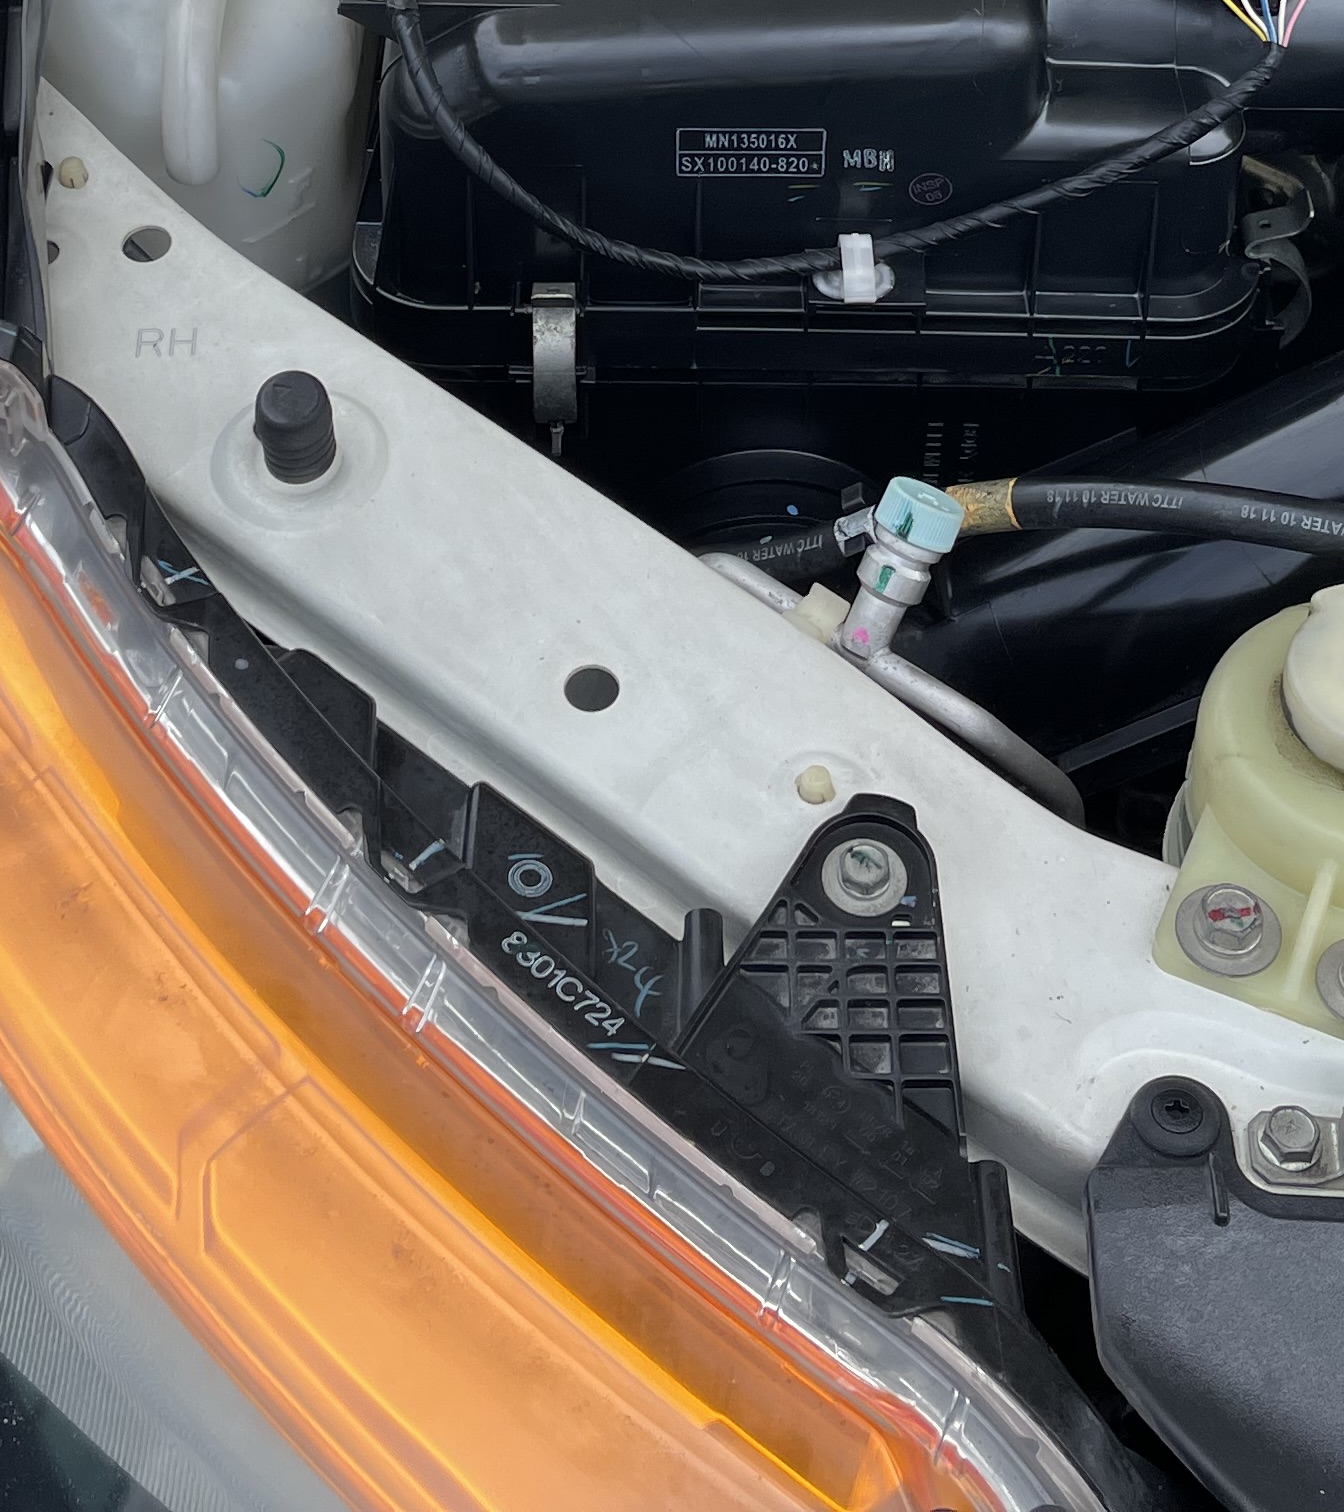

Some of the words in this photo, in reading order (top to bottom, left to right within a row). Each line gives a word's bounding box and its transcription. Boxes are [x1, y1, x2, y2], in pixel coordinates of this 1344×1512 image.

[705, 133, 798, 149] MN135016X
[912, 177, 945, 194] INSP
[135, 328, 198, 358] RH
[1065, 490, 1078, 503] 11
[1082, 489, 1096, 503] 10
[1100, 490, 1149, 506] WATER
[1240, 504, 1256, 520] 18
[1261, 508, 1276, 523] 11
[1280, 511, 1297, 527] 10
[752, 542, 795, 561] WATER
